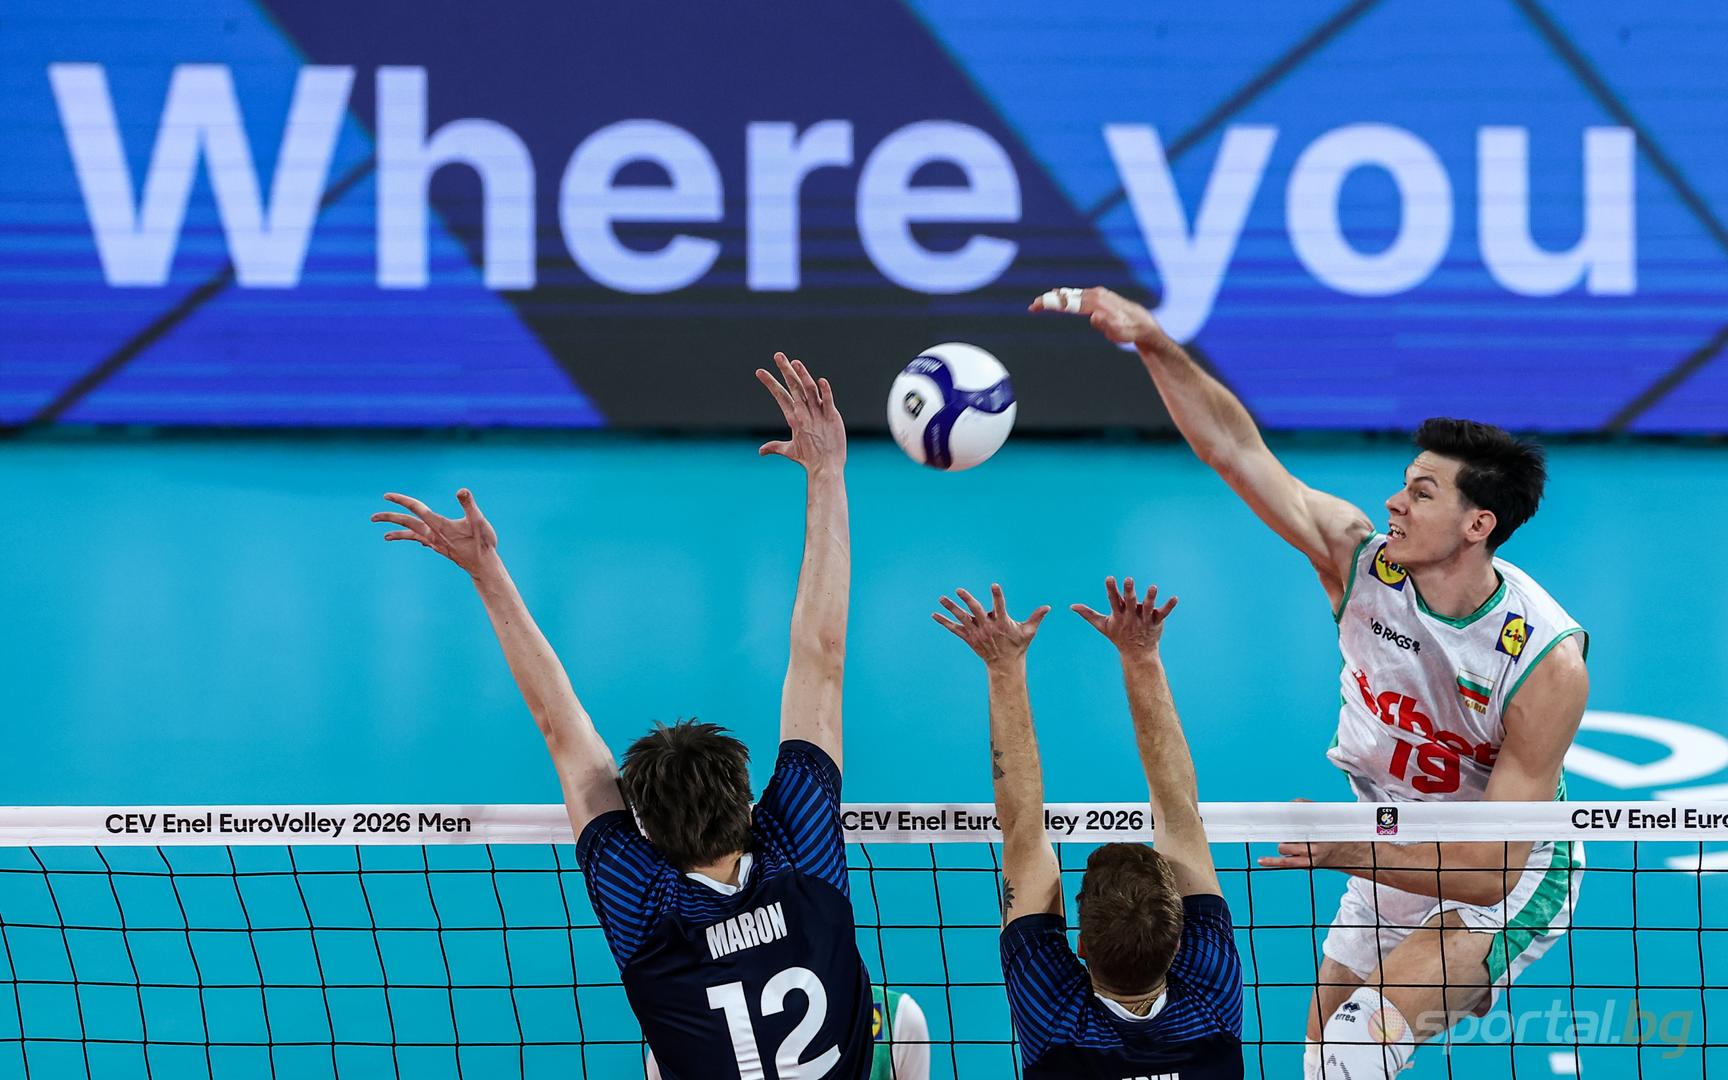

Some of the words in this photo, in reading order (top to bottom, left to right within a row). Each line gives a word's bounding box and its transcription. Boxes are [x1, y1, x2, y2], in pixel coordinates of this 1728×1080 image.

[49, 62, 1022, 294] Where
[1103, 123, 1636, 351] you
[1382, 627, 1413, 650] RAGS
[1389, 738, 1461, 794] 19
[105, 813, 157, 834] CEV
[163, 812, 212, 833] Enel
[219, 811, 347, 838] EuroVolley
[352, 812, 411, 833] 2026
[418, 812, 471, 833] Men
[841, 810, 892, 831] CEV
[897, 809, 947, 831] Enel
[1085, 810, 1144, 831] 2026
[1571, 808, 1622, 829] CEV
[1628, 807, 1677, 829] Enel
[706, 901, 788, 960] MARON
[705, 966, 841, 1080] 12
